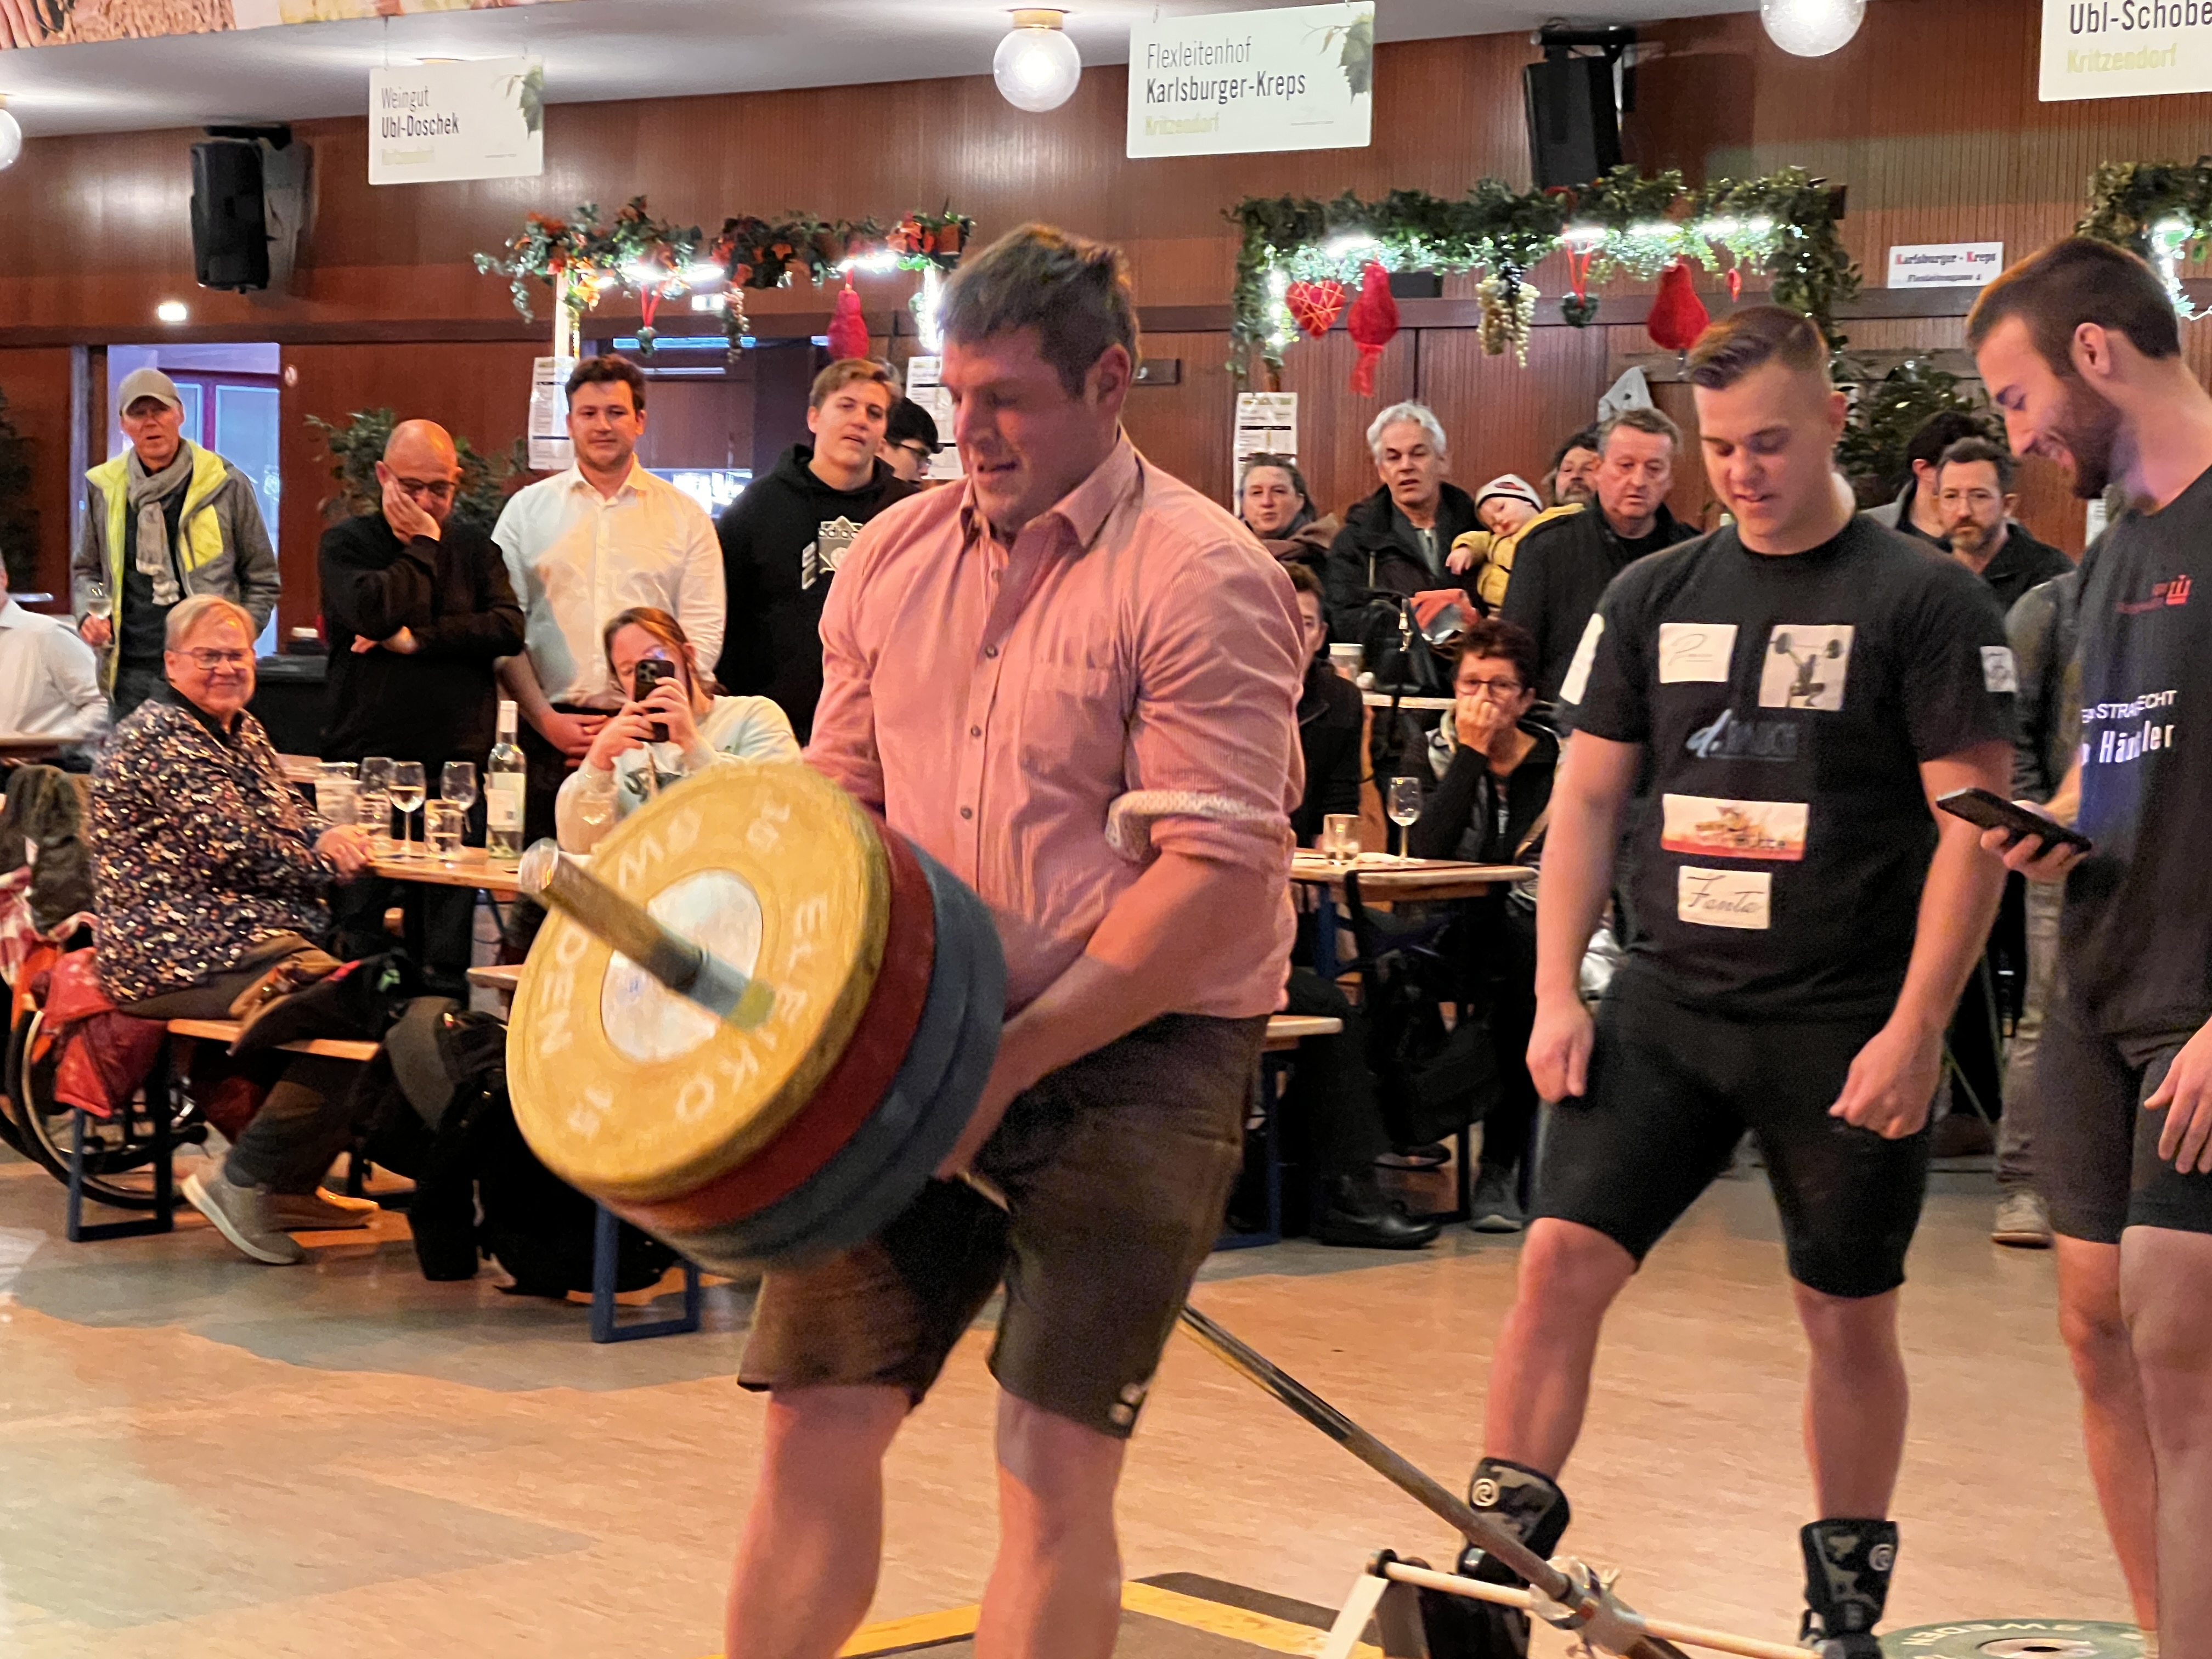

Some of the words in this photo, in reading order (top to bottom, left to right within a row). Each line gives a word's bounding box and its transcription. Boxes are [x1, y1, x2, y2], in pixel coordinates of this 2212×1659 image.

[1148, 36, 1251, 69] Flexleitenhof
[381, 86, 429, 112] Weingut
[1147, 71, 1306, 105] Karlsburger-Kreps
[382, 112, 460, 138] Ubl-Doschek
[1901, 1623, 2084, 1646] SWEDEN
